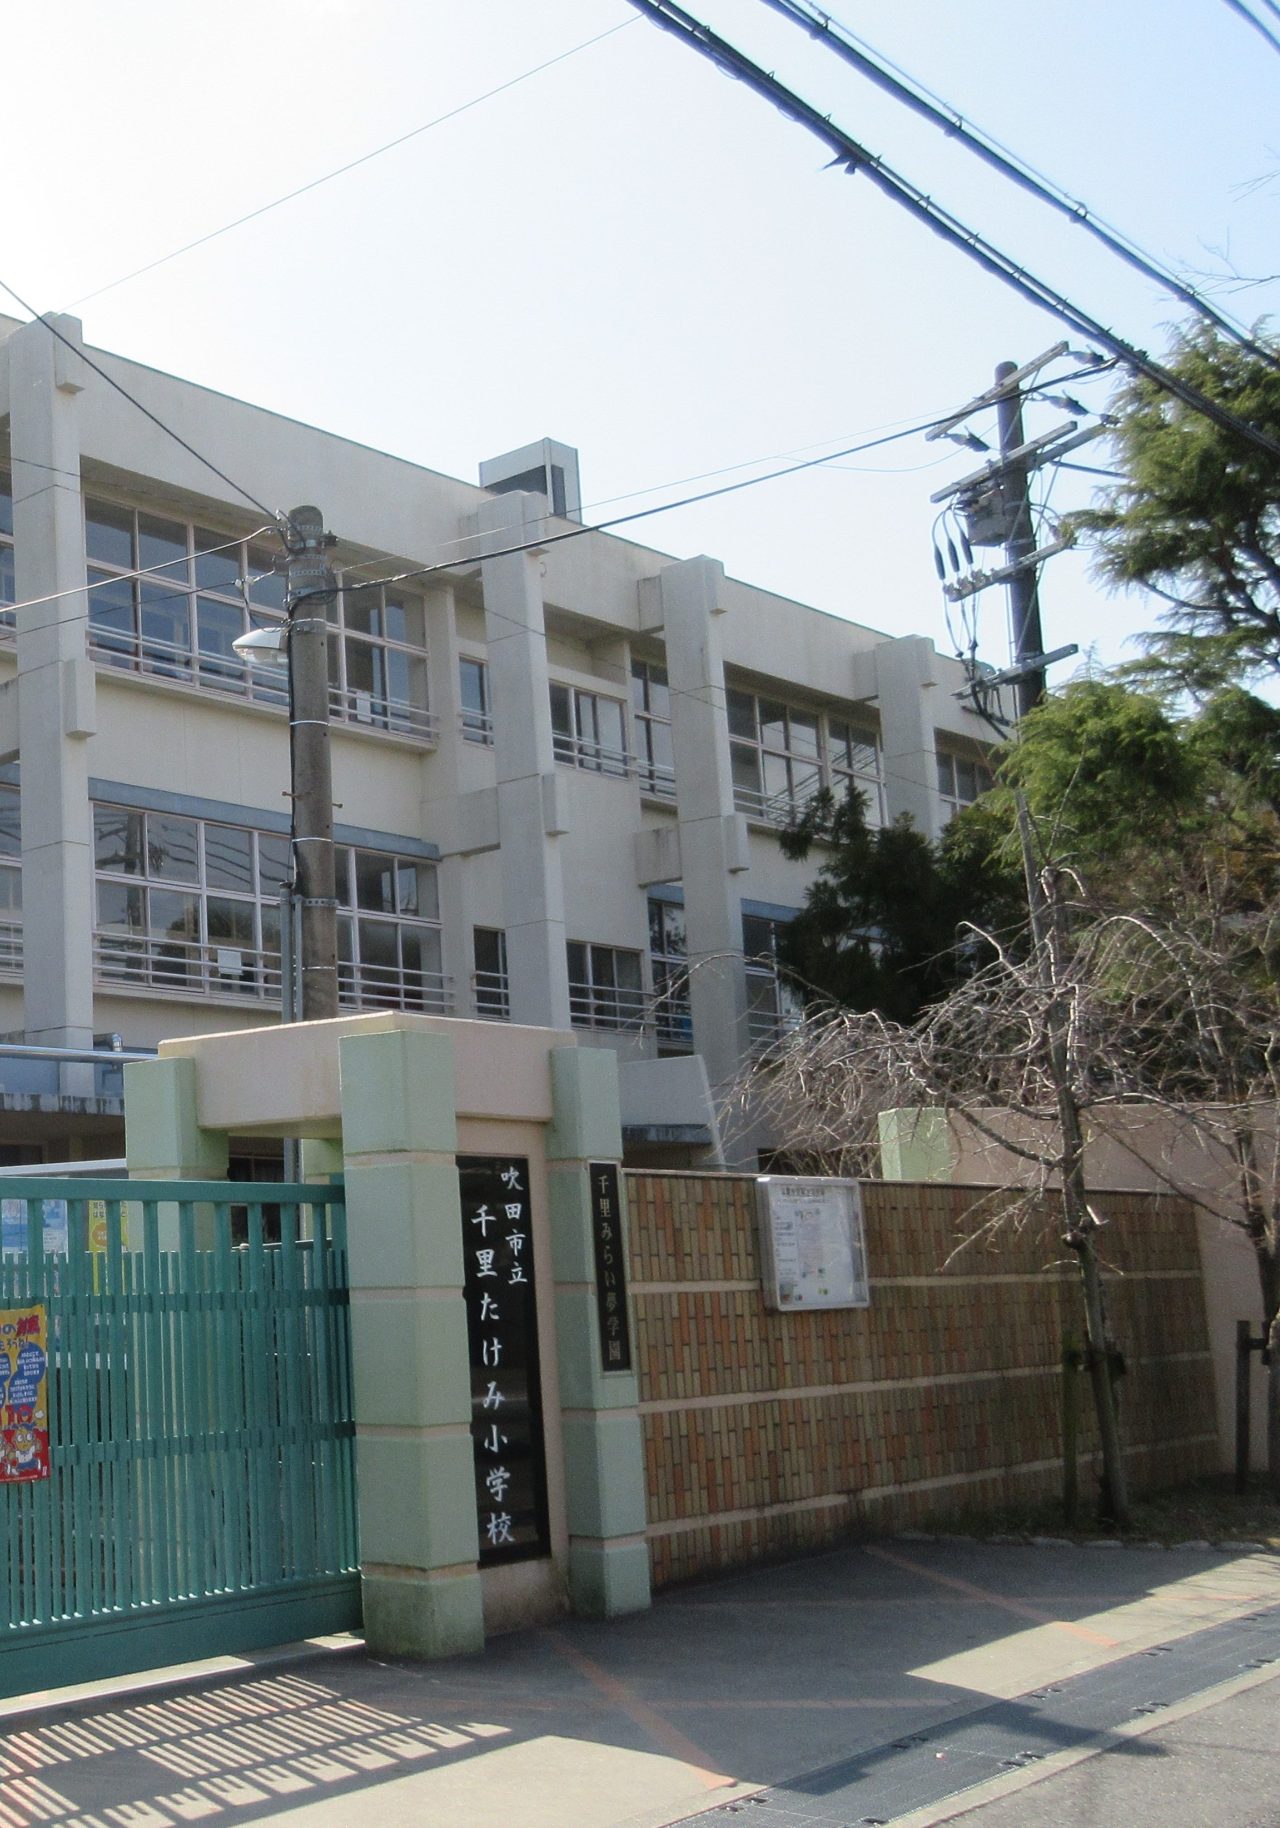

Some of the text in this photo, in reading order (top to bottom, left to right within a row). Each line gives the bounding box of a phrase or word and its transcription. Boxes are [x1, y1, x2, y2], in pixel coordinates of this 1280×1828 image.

[500, 1166, 528, 1286] 吹田市立
[597, 1175, 621, 1361] 千里みらい夢学園
[471, 1204, 515, 1546] 千里たけみ小学校
